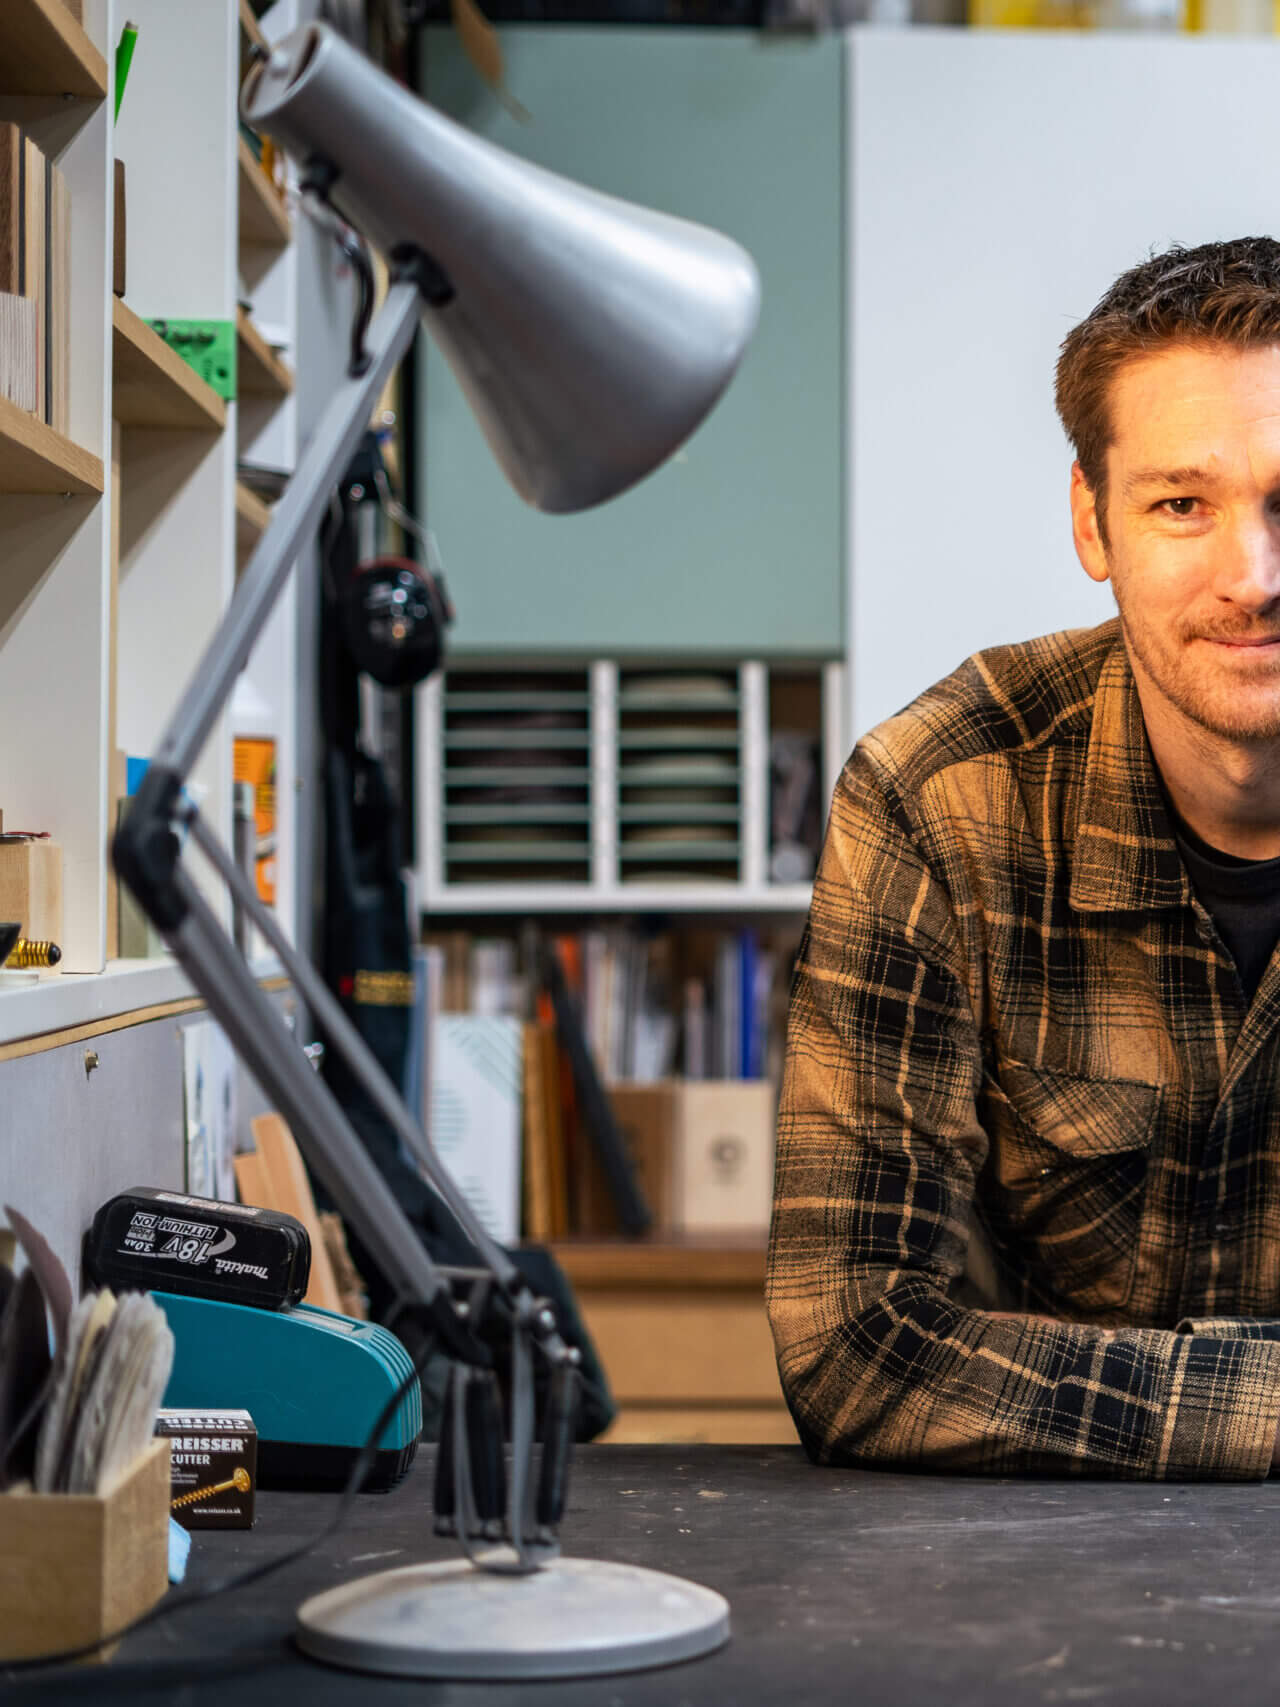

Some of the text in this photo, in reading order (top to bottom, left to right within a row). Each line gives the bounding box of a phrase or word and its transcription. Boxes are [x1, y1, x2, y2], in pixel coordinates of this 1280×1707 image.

[124, 1238, 154, 1252] 3.0Ah
[161, 1236, 213, 1264] 18V
[171, 1437, 244, 1453] REISSER
[170, 1453, 210, 1465] CUTTER
